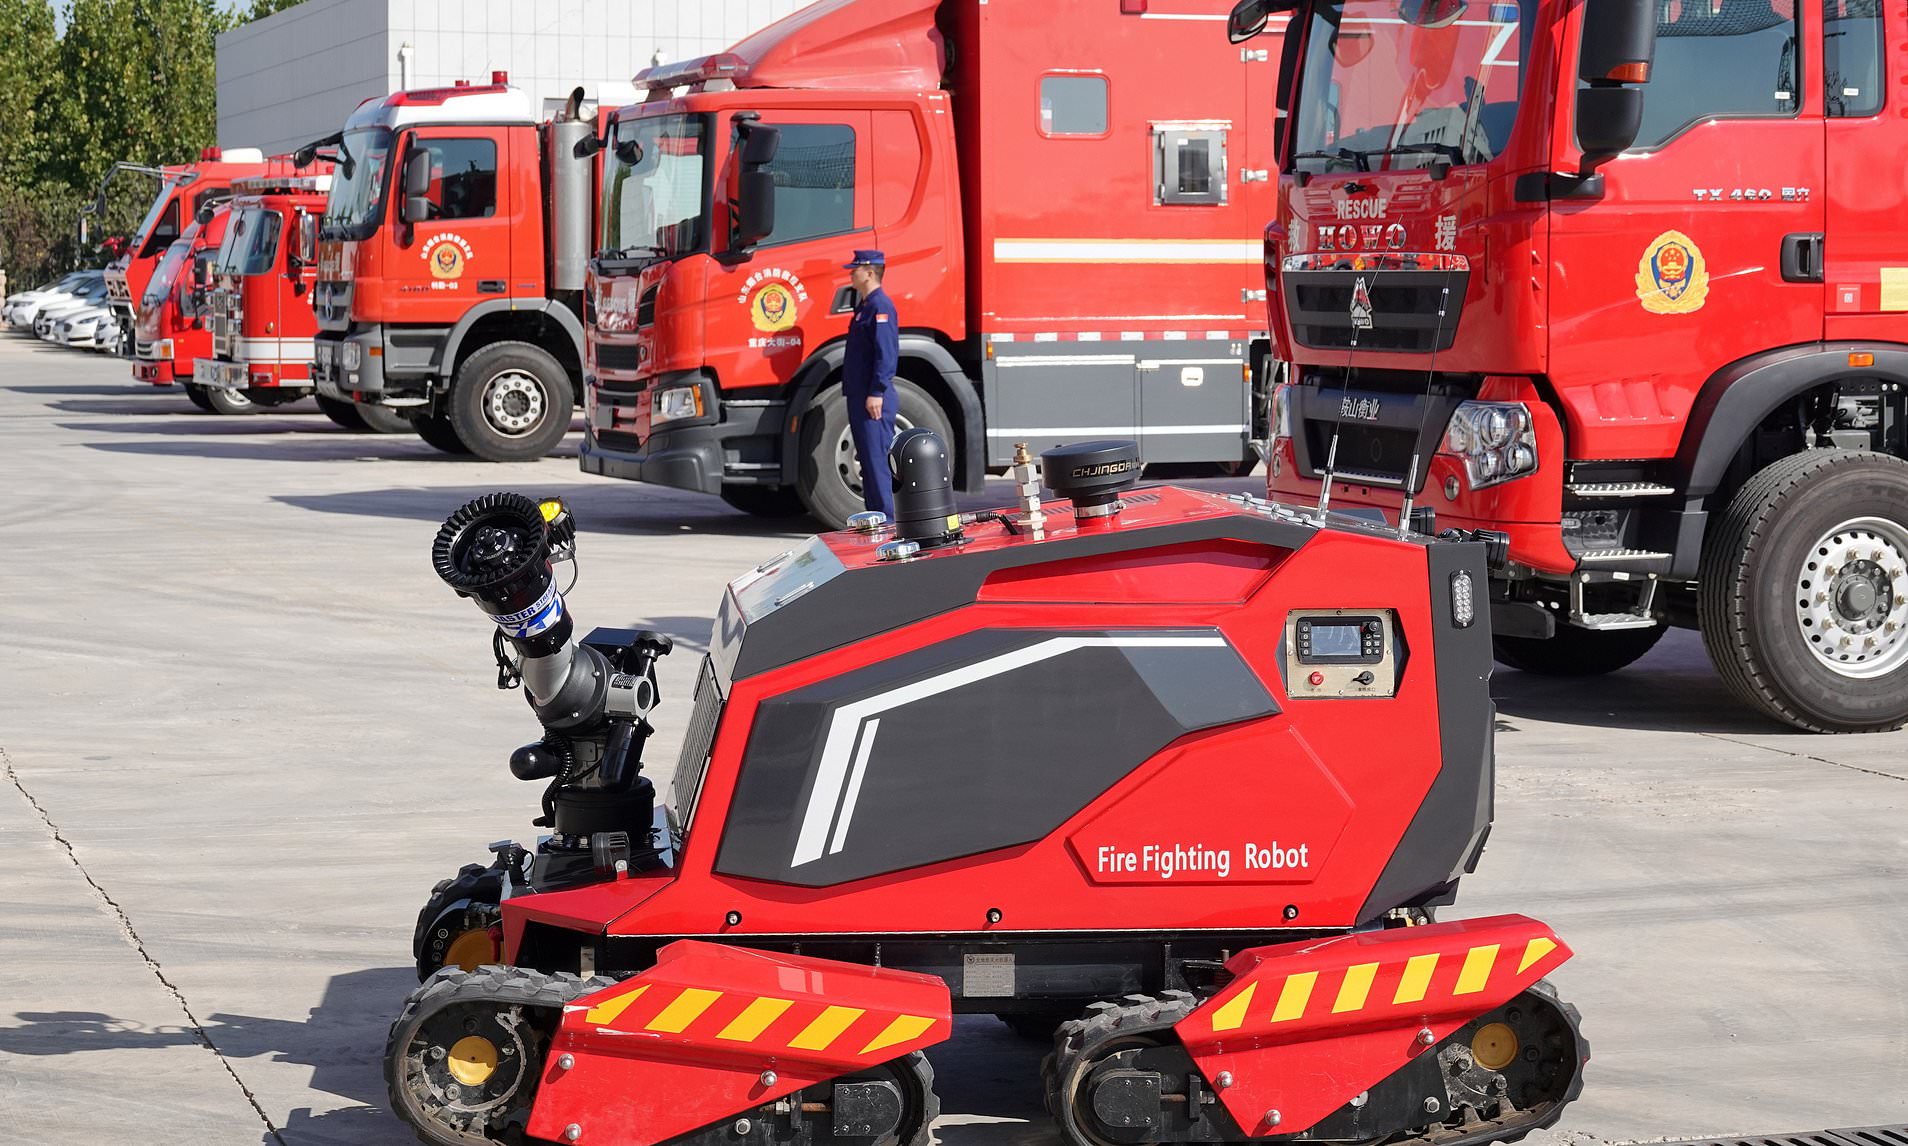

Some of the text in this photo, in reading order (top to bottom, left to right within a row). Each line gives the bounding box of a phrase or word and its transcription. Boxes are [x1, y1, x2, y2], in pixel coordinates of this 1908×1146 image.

[1692, 188, 1723, 201] TX
[1729, 188, 1772, 201] 460
[1337, 198, 1387, 220] RESCUE
[1318, 223, 1407, 250] HOWO
[1435, 215, 1457, 251] 援
[1098, 841, 1309, 879] Fire Fighting Robot
